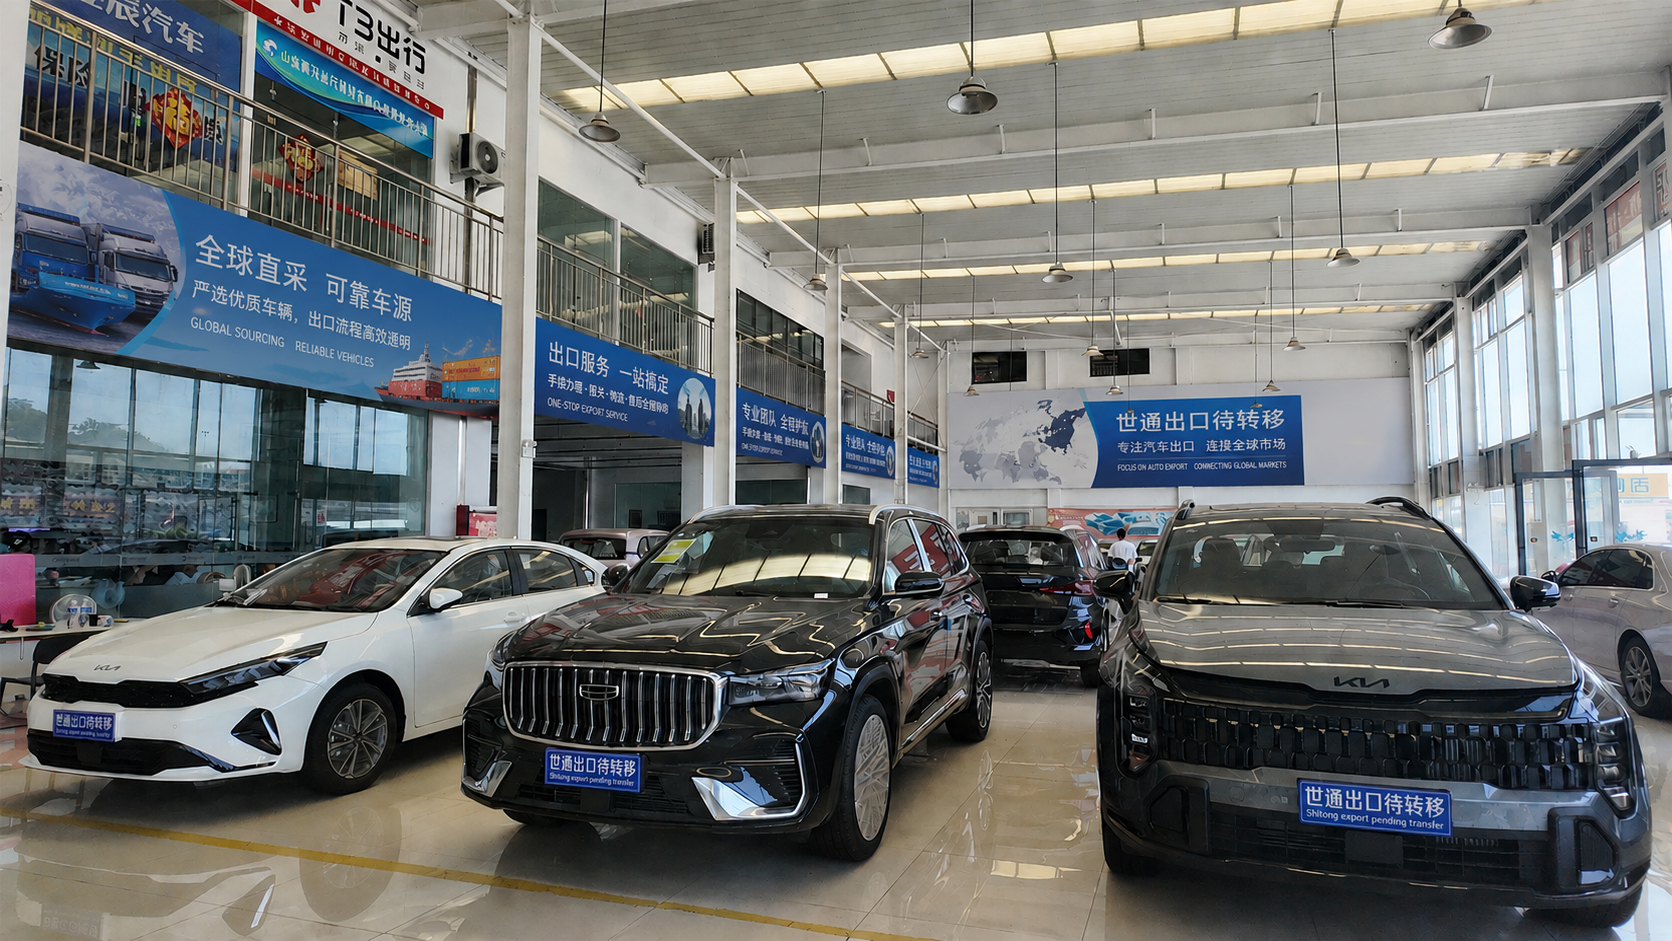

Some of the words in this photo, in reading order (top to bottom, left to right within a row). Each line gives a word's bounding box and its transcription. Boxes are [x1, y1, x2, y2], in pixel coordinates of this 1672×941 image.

[195, 234, 307, 292] 全球直采
[325, 273, 412, 322] 可靠车源
[190, 316, 232, 337] GLOBAL
[234, 326, 285, 348] SOURCING
[295, 340, 335, 359] RELIABLE
[336, 350, 375, 367] VEHICLES
[549, 341, 609, 378] 出口服务
[619, 366, 669, 395] 一站搞定
[1116, 408, 1285, 433] 世通出口待转移
[1117, 440, 1195, 454] 专注汽车出口
[1117, 463, 1137, 472] FOCUS
[1137, 463, 1147, 471] ON
[1147, 463, 1164, 471] AUTO
[1258, 461, 1287, 469] MARKETS
[550, 753, 636, 778] 世通出口待转移
[1305, 785, 1445, 819] 世通出口待转移
[1306, 808, 1339, 822] Shitong
[1341, 813, 1369, 823] export
[1371, 815, 1407, 828] pending
[1409, 819, 1444, 830] transfer
